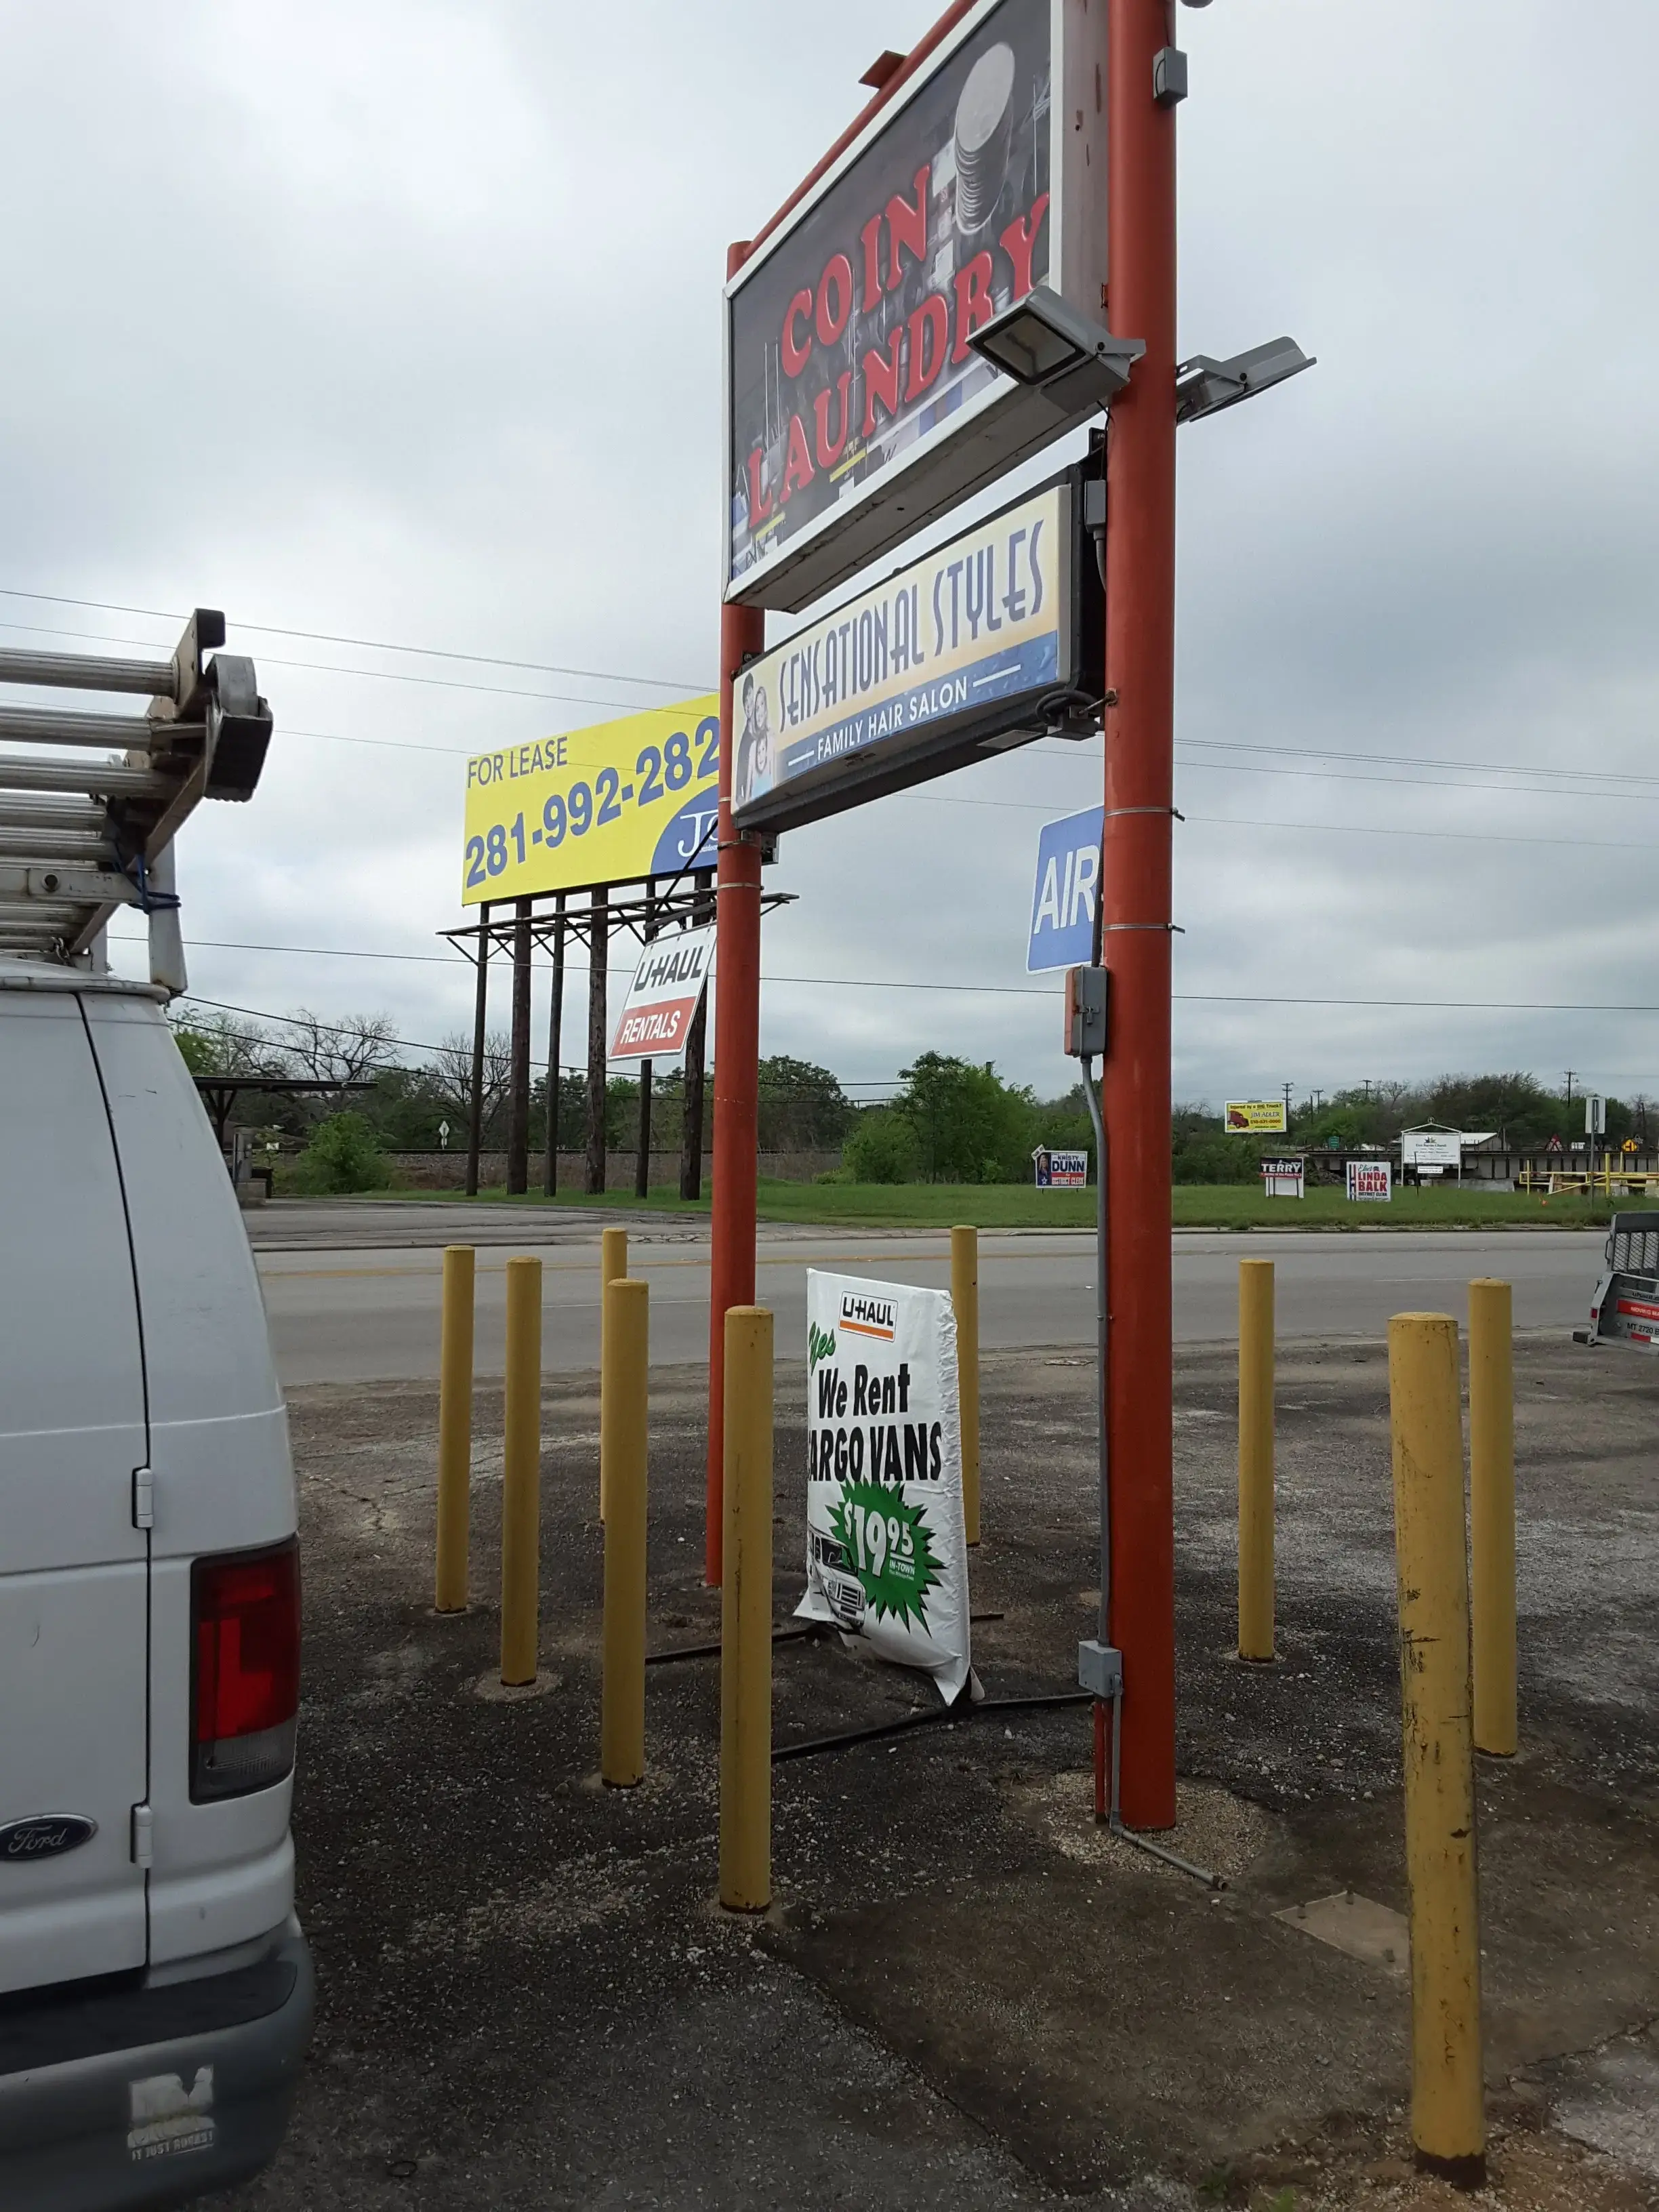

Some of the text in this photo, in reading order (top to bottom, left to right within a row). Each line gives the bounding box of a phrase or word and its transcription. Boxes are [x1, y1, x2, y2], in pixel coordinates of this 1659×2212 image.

[781, 163, 930, 377] COIN
[747, 192, 1049, 527] LAUNDRY
[779, 520, 1044, 733] SENSATIONAL STYLES
[817, 676, 968, 760] FAMILY HAIR SALON
[468, 736, 567, 788] FOR LEASE
[1033, 844, 1100, 935] AIR
[634, 945, 704, 992] U-HAUL
[620, 1010, 681, 1044] RENTALS
[1052, 1160, 1085, 1172] DUNN
[1261, 1163, 1301, 1172] TERRY
[1358, 1172, 1387, 1181] LINDA
[1358, 1181, 1387, 1192] BALK
[842, 1296, 894, 1327] U-HAUL
[809, 1321, 836, 1376] Yes
[819, 1363, 911, 1418] We Rent
[808, 1421, 942, 1481] ARGO VANS
[889, 1559, 915, 1575] IN-TOWN
[8, 1824, 68, 1853] Ford
